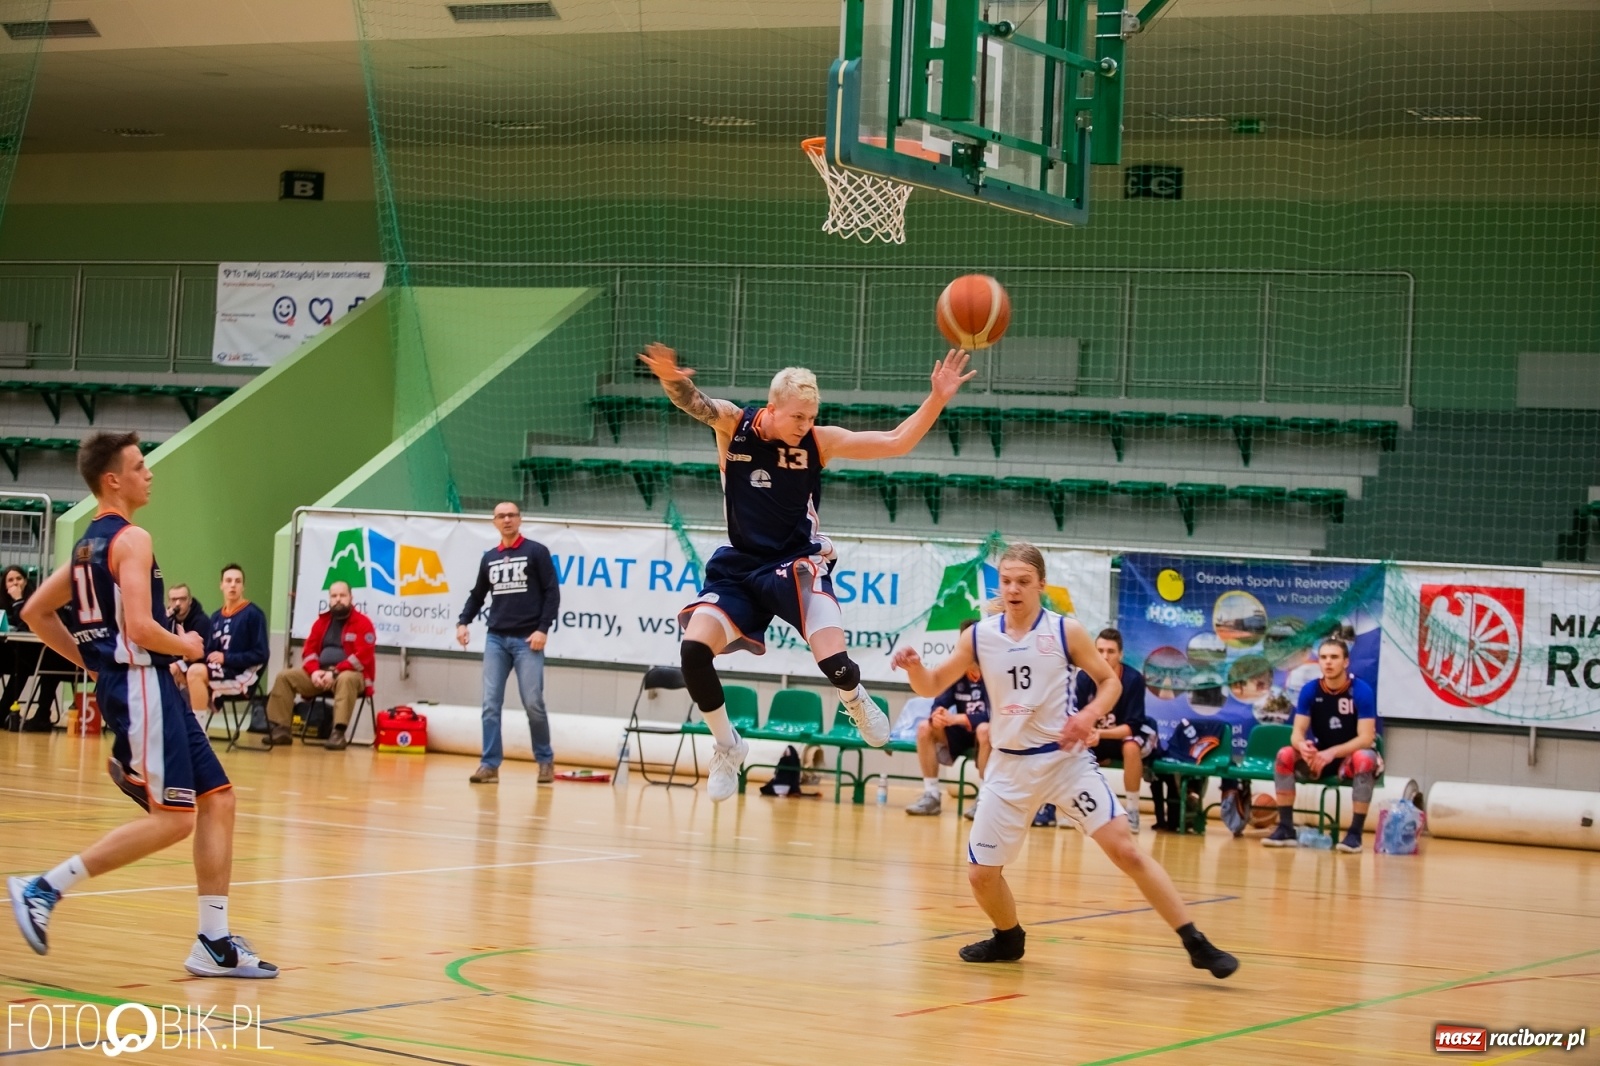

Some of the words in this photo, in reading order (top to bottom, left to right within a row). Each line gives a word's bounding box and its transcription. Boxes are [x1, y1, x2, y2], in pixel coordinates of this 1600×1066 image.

[293, 180, 315, 197] B
[1150, 176, 1176, 195] C
[777, 447, 809, 470] 13
[489, 561, 528, 585] GTK
[1196, 571, 1244, 586] Ośrodek
[1247, 574, 1285, 588] Sportu
[1288, 577, 1292, 588] i
[1295, 577, 1350, 592] Rekreacji
[73, 564, 103, 625] 11
[1276, 593, 1288, 603] w
[377, 601, 450, 620] raciborski
[1006, 665, 1032, 690] 13
[1071, 790, 1098, 818] 13
